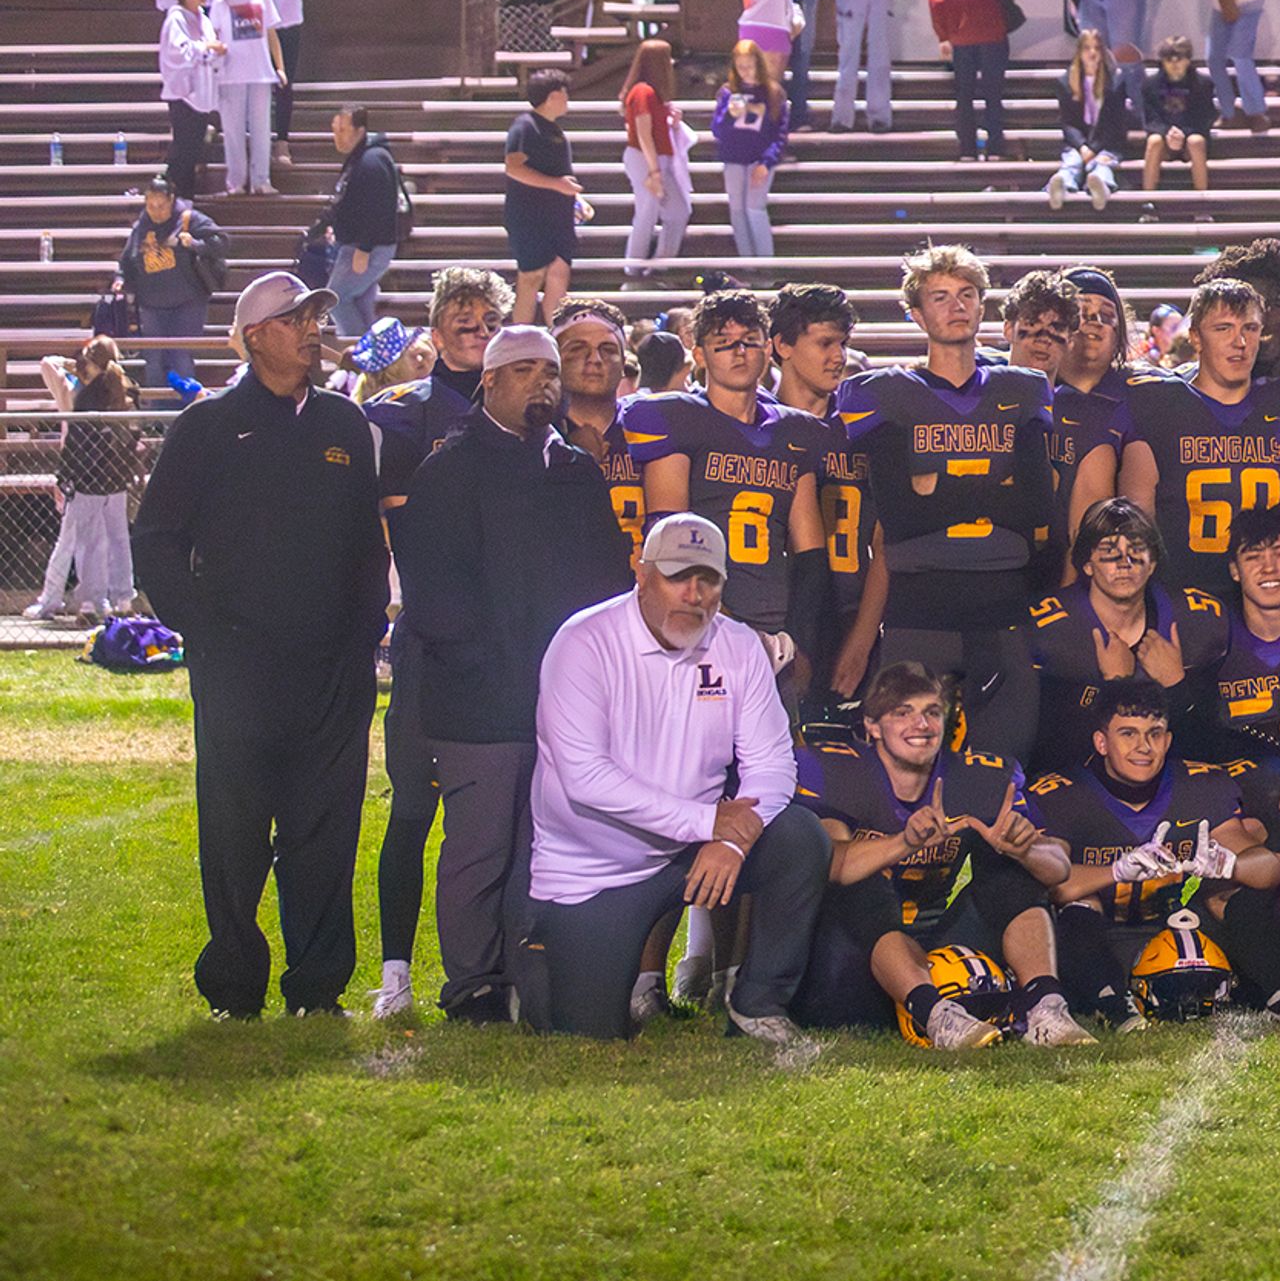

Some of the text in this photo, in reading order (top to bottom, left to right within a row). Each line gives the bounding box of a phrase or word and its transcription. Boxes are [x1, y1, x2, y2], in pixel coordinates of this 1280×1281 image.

[913, 423, 1018, 453] BENGALS
[1180, 436, 1280, 464] BENGALS
[704, 452, 800, 491] BENGALS
[697, 663, 723, 689] L
